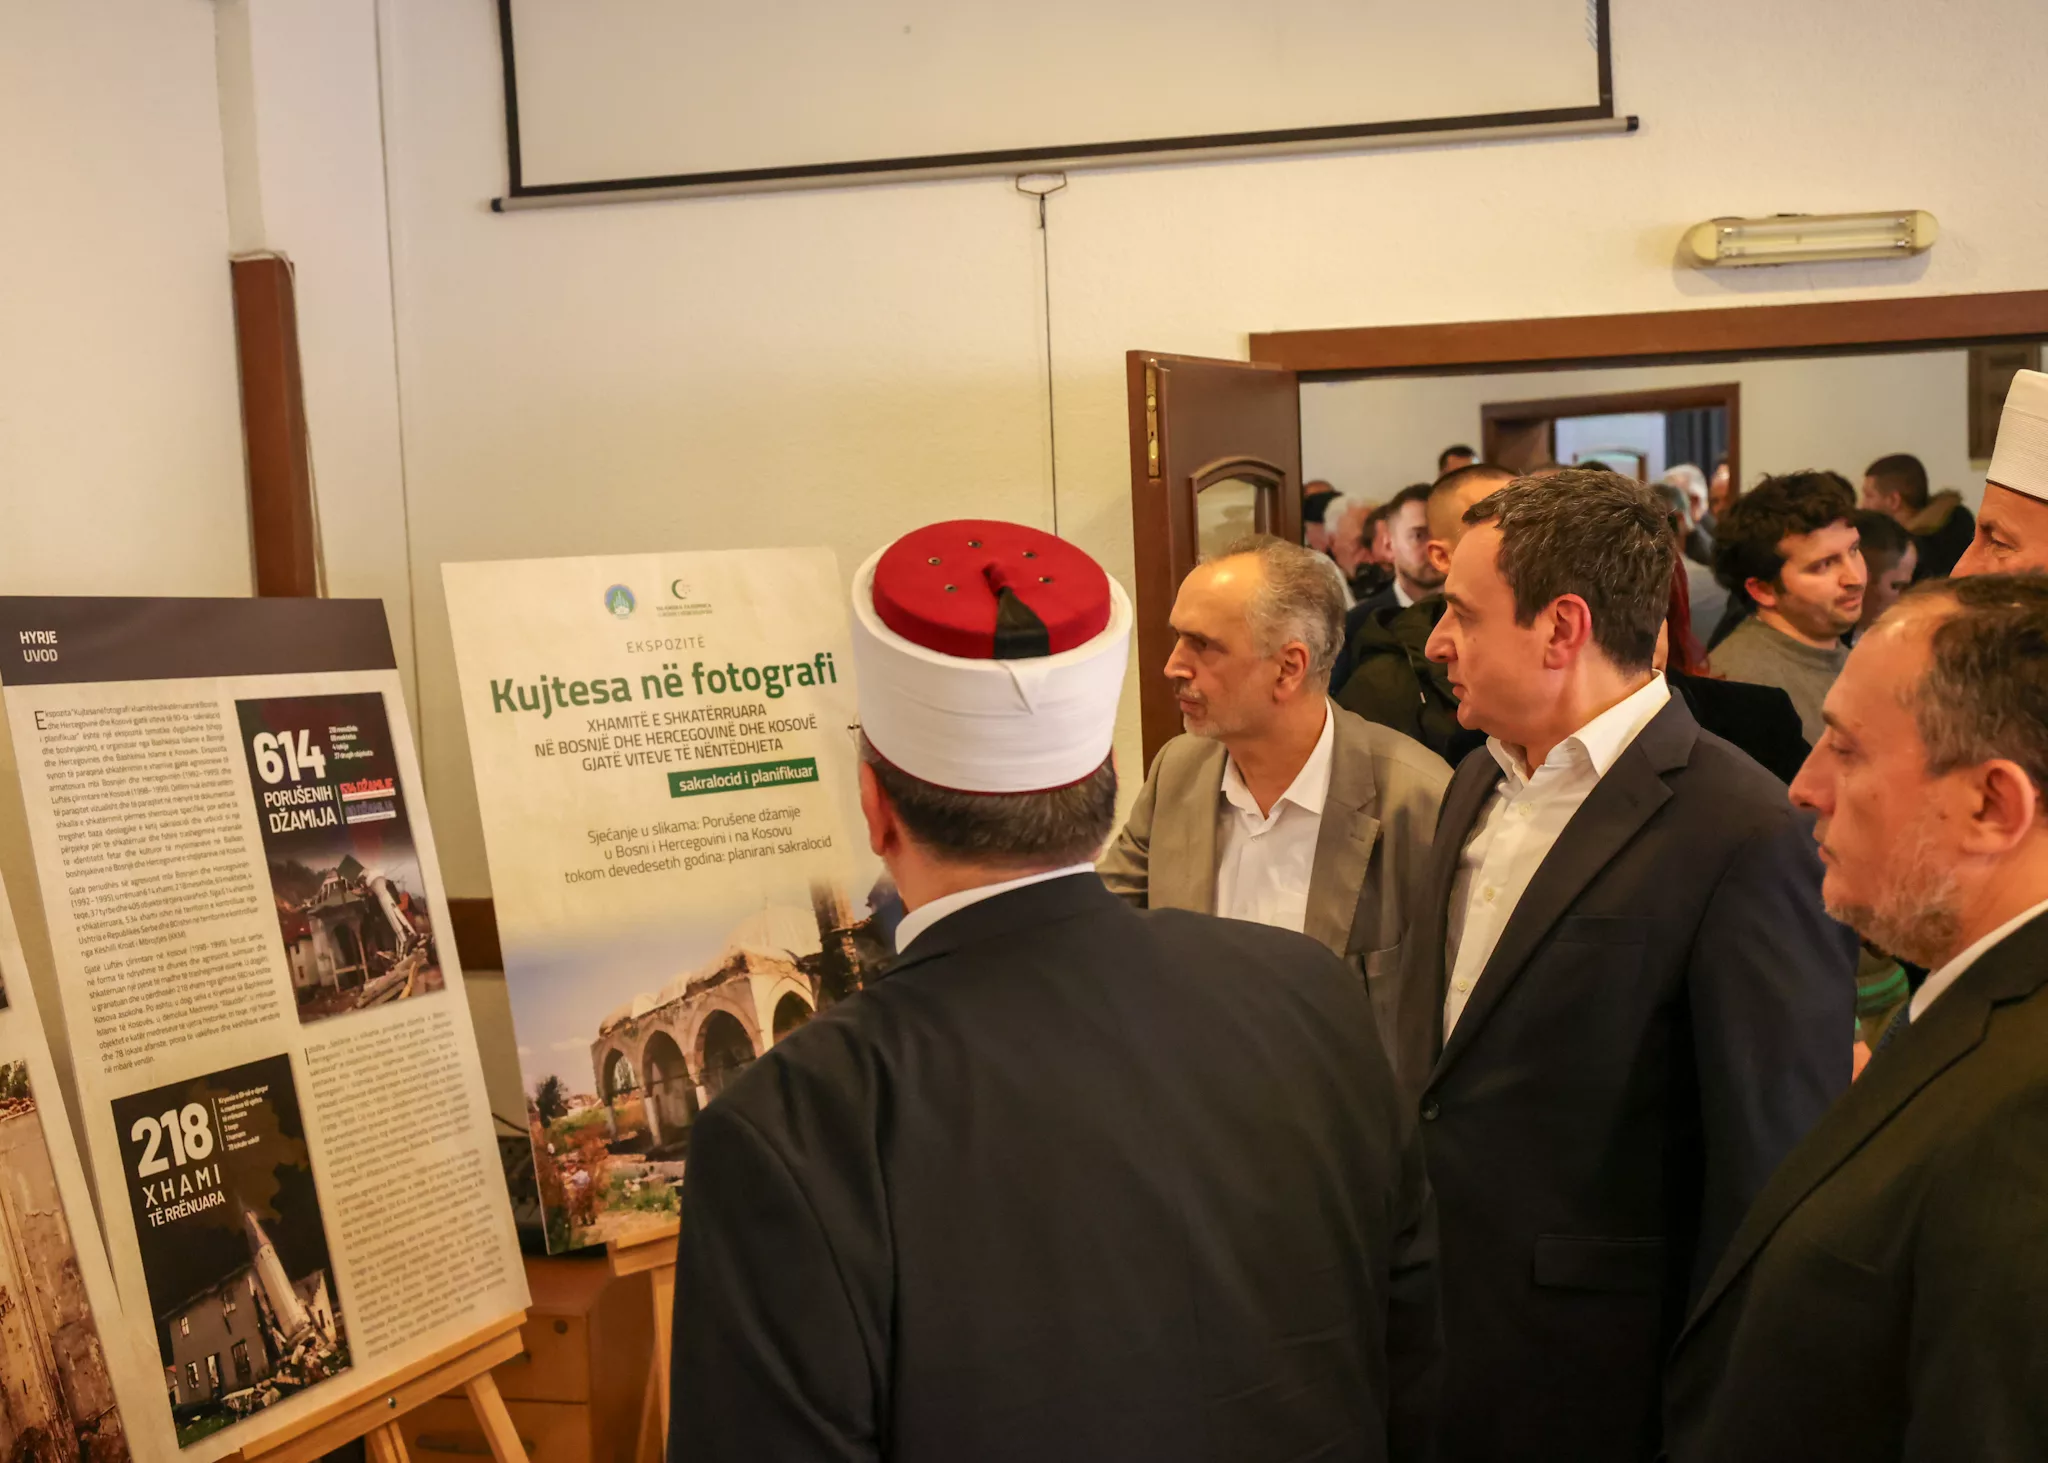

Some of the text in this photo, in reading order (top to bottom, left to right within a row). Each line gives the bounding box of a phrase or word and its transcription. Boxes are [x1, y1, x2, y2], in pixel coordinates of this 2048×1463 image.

[19, 630, 58, 644] HYRJE
[626, 636, 705, 653] EKSPOZITË
[23, 648, 58, 663] UVOD
[490, 652, 838, 720] Kujtesa në fotografi
[586, 704, 766, 732] XHAMITË E SHKATËRRUARA
[534, 714, 817, 756] NË BOSNJË DHE HERCEGOVINË DHE KOSOVË
[253, 729, 326, 784] 614
[582, 738, 783, 771] GJATË VITEVE TË NËNTËDHJETA
[678, 764, 814, 792] sakralocid i planifikuar
[263, 784, 334, 808] PORUŠENIH
[269, 806, 337, 833] DŽAMIJA
[588, 806, 800, 845] Sjećanje u slikama: Porušene džamije
[604, 826, 792, 859] u Bosni i Hercegovini i na Kosovu
[564, 836, 832, 883] tokom devedesetih godina: planirani sakralocid
[131, 1102, 214, 1178] 218
[142, 1163, 222, 1208] XHAMI
[149, 1190, 226, 1228] TË RRËNUARA
